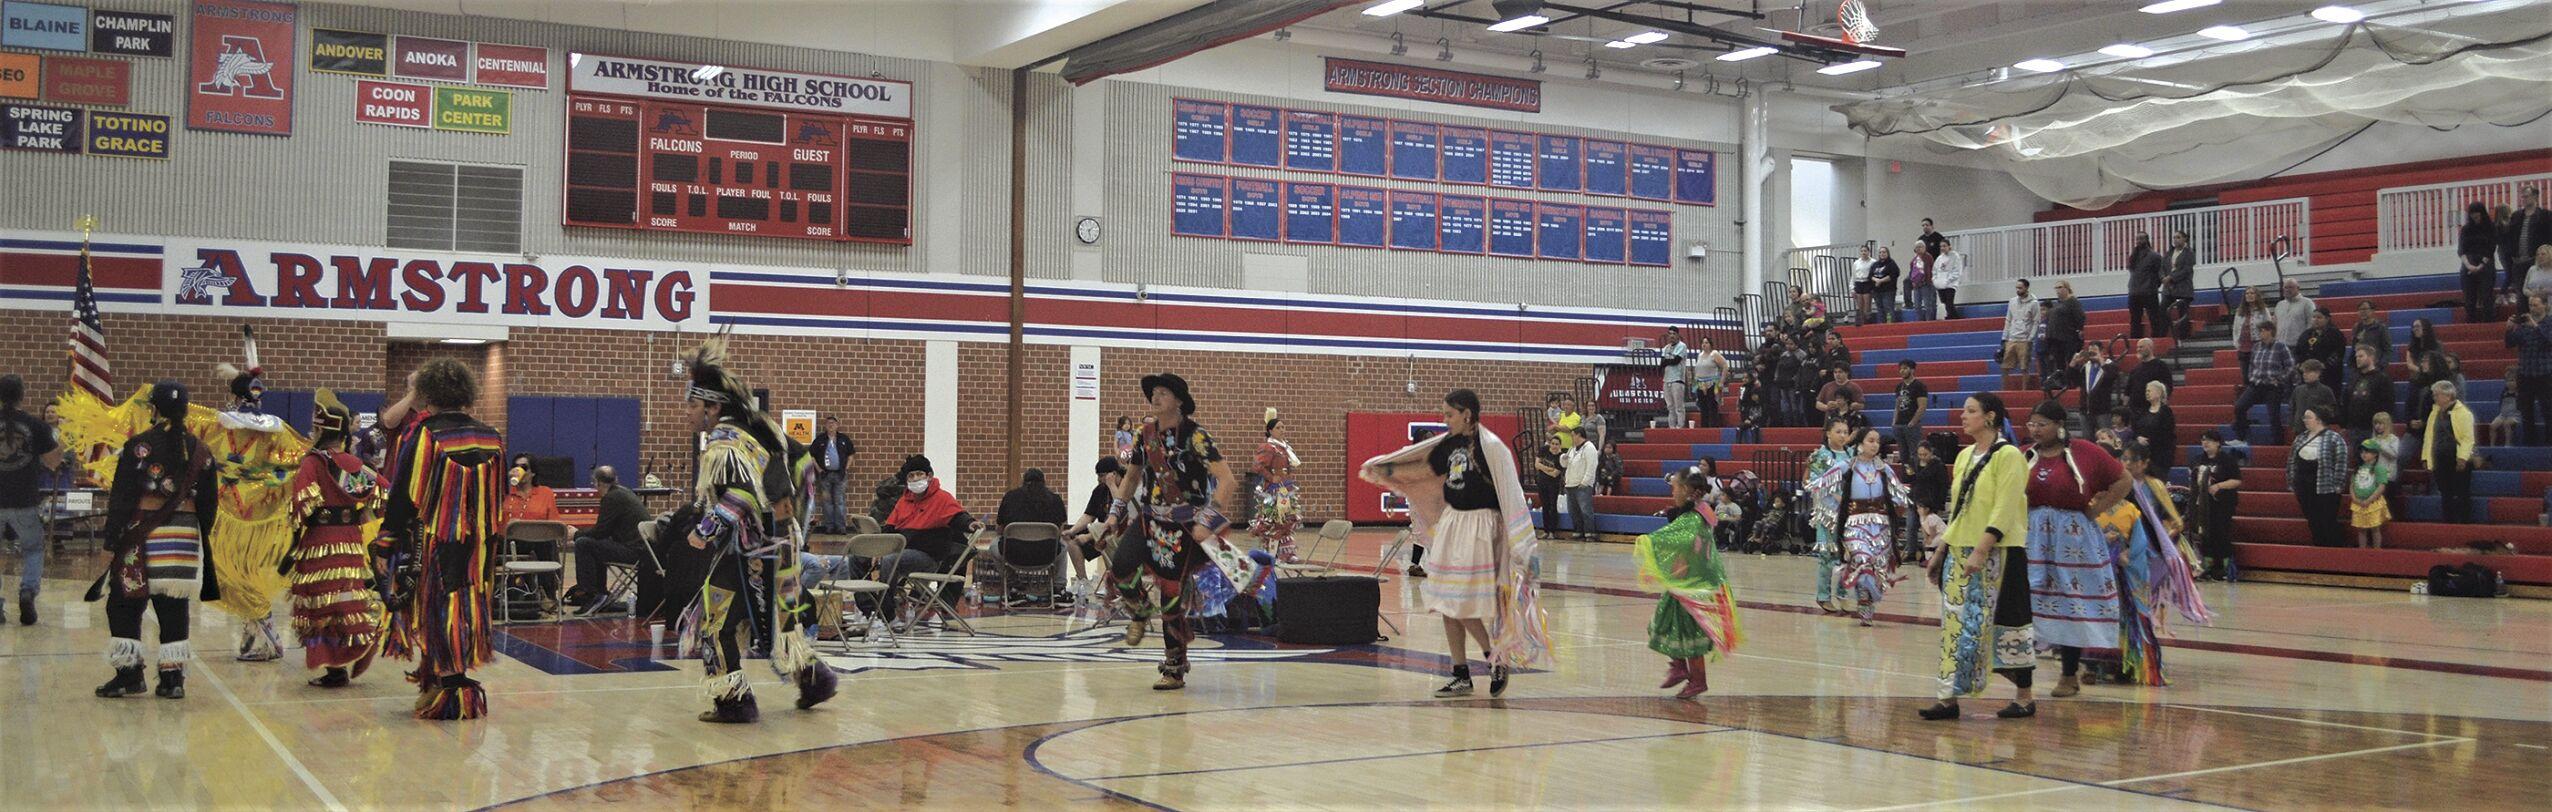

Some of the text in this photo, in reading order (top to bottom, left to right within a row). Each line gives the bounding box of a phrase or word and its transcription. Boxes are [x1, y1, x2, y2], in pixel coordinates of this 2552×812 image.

[196, 4, 294, 24] ARMSTRONG
[10, 17, 81, 34] BLAINE
[95, 16, 172, 33] CHAMPLIN
[116, 36, 151, 50] PARK
[316, 43, 384, 60] ANDOVER
[405, 51, 457, 67] ANOKA
[478, 57, 546, 74] CENTENNIAL
[0, 68, 25, 81] EO
[59, 64, 116, 79] MAPLE
[594, 61, 892, 102] ARMSTRONG HIGH SCHOOL
[1329, 66, 1539, 106] ARMSTRONG SECTION CHAMPIONS
[60, 82, 115, 97] GROVE
[372, 87, 416, 102] COON
[648, 82, 842, 108] Home of the FALCONS
[453, 94, 493, 108] PARK
[575, 102, 592, 112] PLYR
[9, 107, 73, 122] SPRING
[365, 105, 421, 120] RAPIDS
[599, 104, 611, 114] FLS
[620, 105, 633, 115] PTS
[94, 116, 167, 133] TOTINO
[207, 111, 274, 127] FALCONS
[442, 110, 502, 126] CENTER
[19, 121, 63, 135] LAKE
[853, 125, 868, 134] PLYR
[874, 125, 885, 135] FLS
[893, 127, 904, 137] PTS
[17, 135, 62, 149] PARK
[95, 136, 163, 153] GRACE
[650, 138, 703, 153] FALCONS
[730, 151, 759, 160] PERIOD
[794, 149, 830, 162] GUEST
[651, 183, 677, 193] FOULS
[687, 185, 709, 195] T.O.L.
[716, 188, 771, 199] PLAYER FOUL
[780, 191, 800, 201] T.O.L.
[808, 193, 831, 203] FOULS
[651, 218, 677, 227] SCORE
[728, 222, 756, 231] MATCH
[807, 226, 832, 236] SCORE
[175, 247, 696, 323] ARMSTRONG
